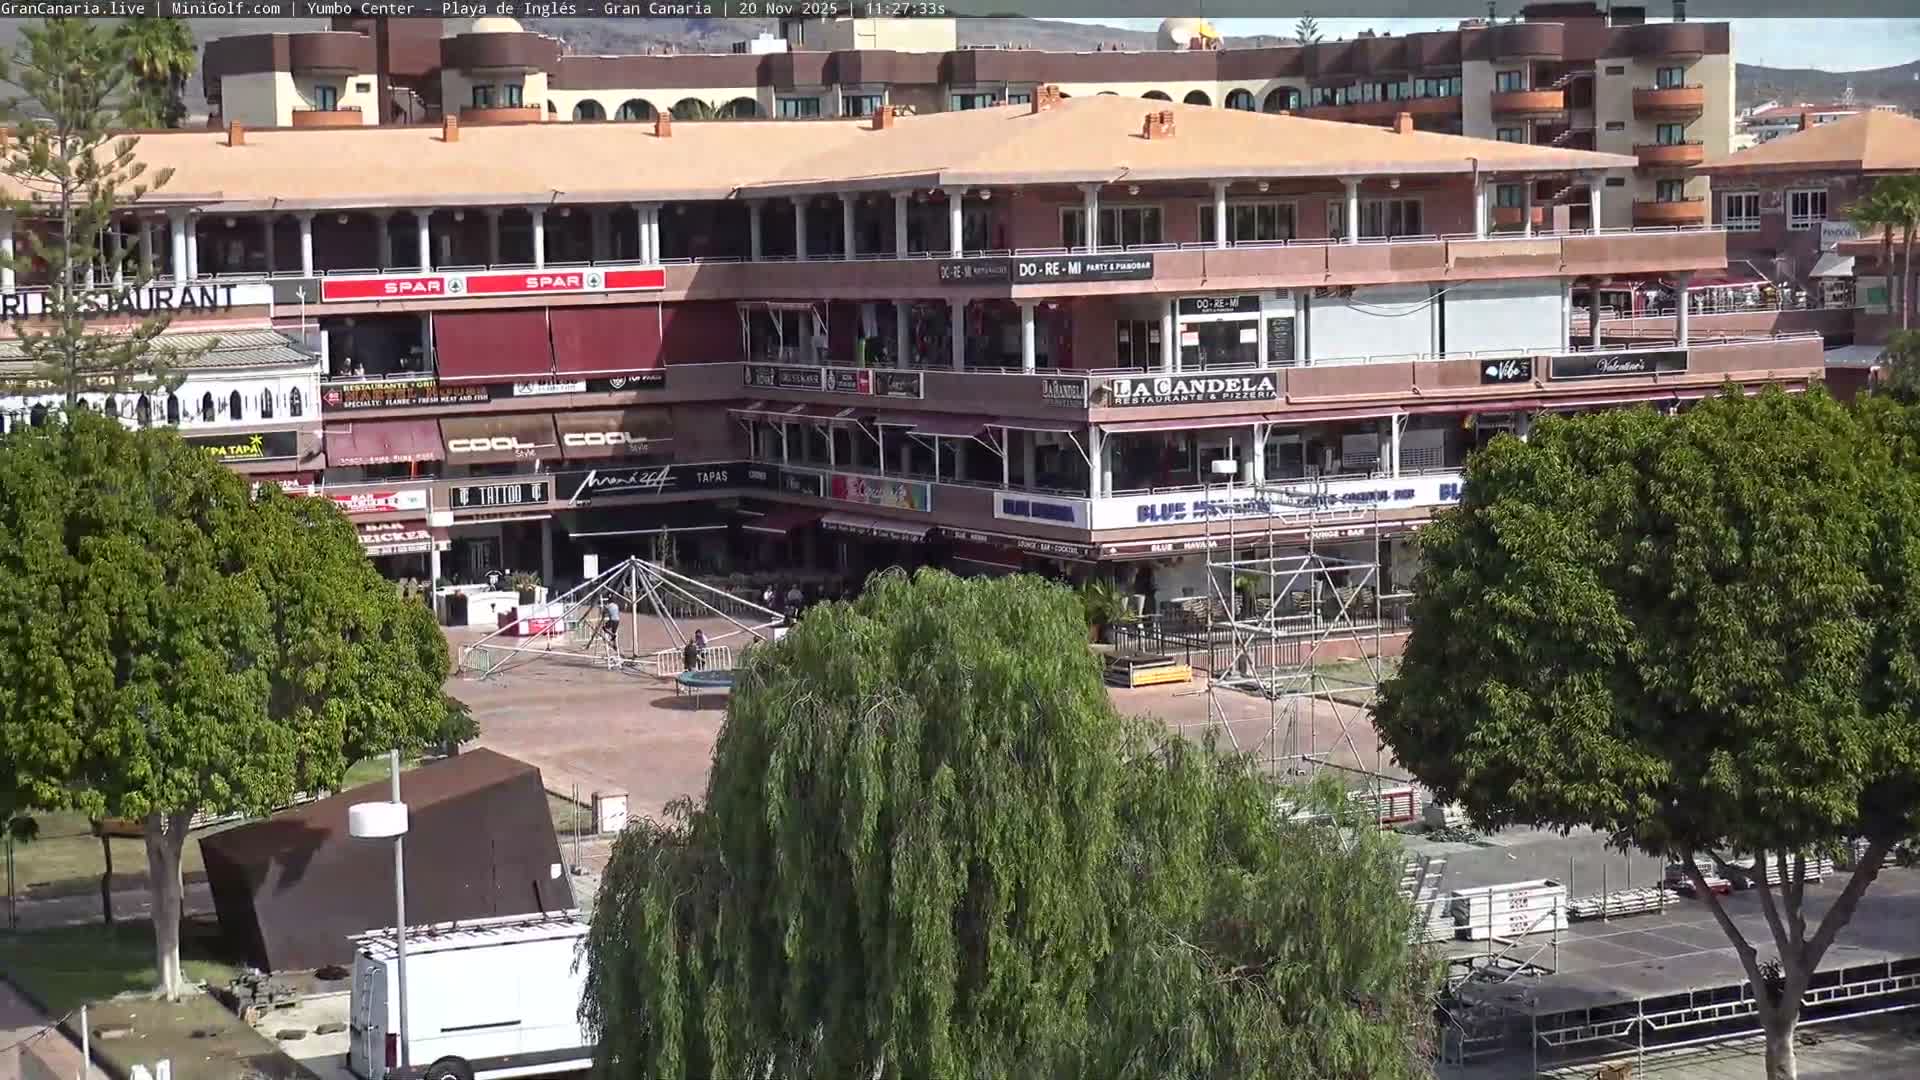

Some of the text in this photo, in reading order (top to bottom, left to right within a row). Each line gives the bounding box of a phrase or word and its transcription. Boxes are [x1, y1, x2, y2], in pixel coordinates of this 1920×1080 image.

[1019, 263, 1037, 277] DO
[1045, 262, 1060, 276] RE
[1068, 261, 1082, 275] MI
[1086, 263, 1108, 272] PARTY
[384, 280, 441, 294] SPAR
[525, 275, 580, 289] SPAR
[1498, 359, 1521, 380] Vibe
[343, 382, 409, 392] RESTAURANTE
[1114, 376, 1275, 397] LA CANDELA
[1115, 391, 1278, 405] RESTAURANTE & PIZZERIA
[448, 436, 536, 452] COOL
[563, 432, 649, 447] COOL
[696, 470, 728, 483] TAPAS
[480, 484, 521, 505] TATTOO
[1137, 502, 1187, 523] BLUE
[1151, 543, 1173, 552] BLUE
